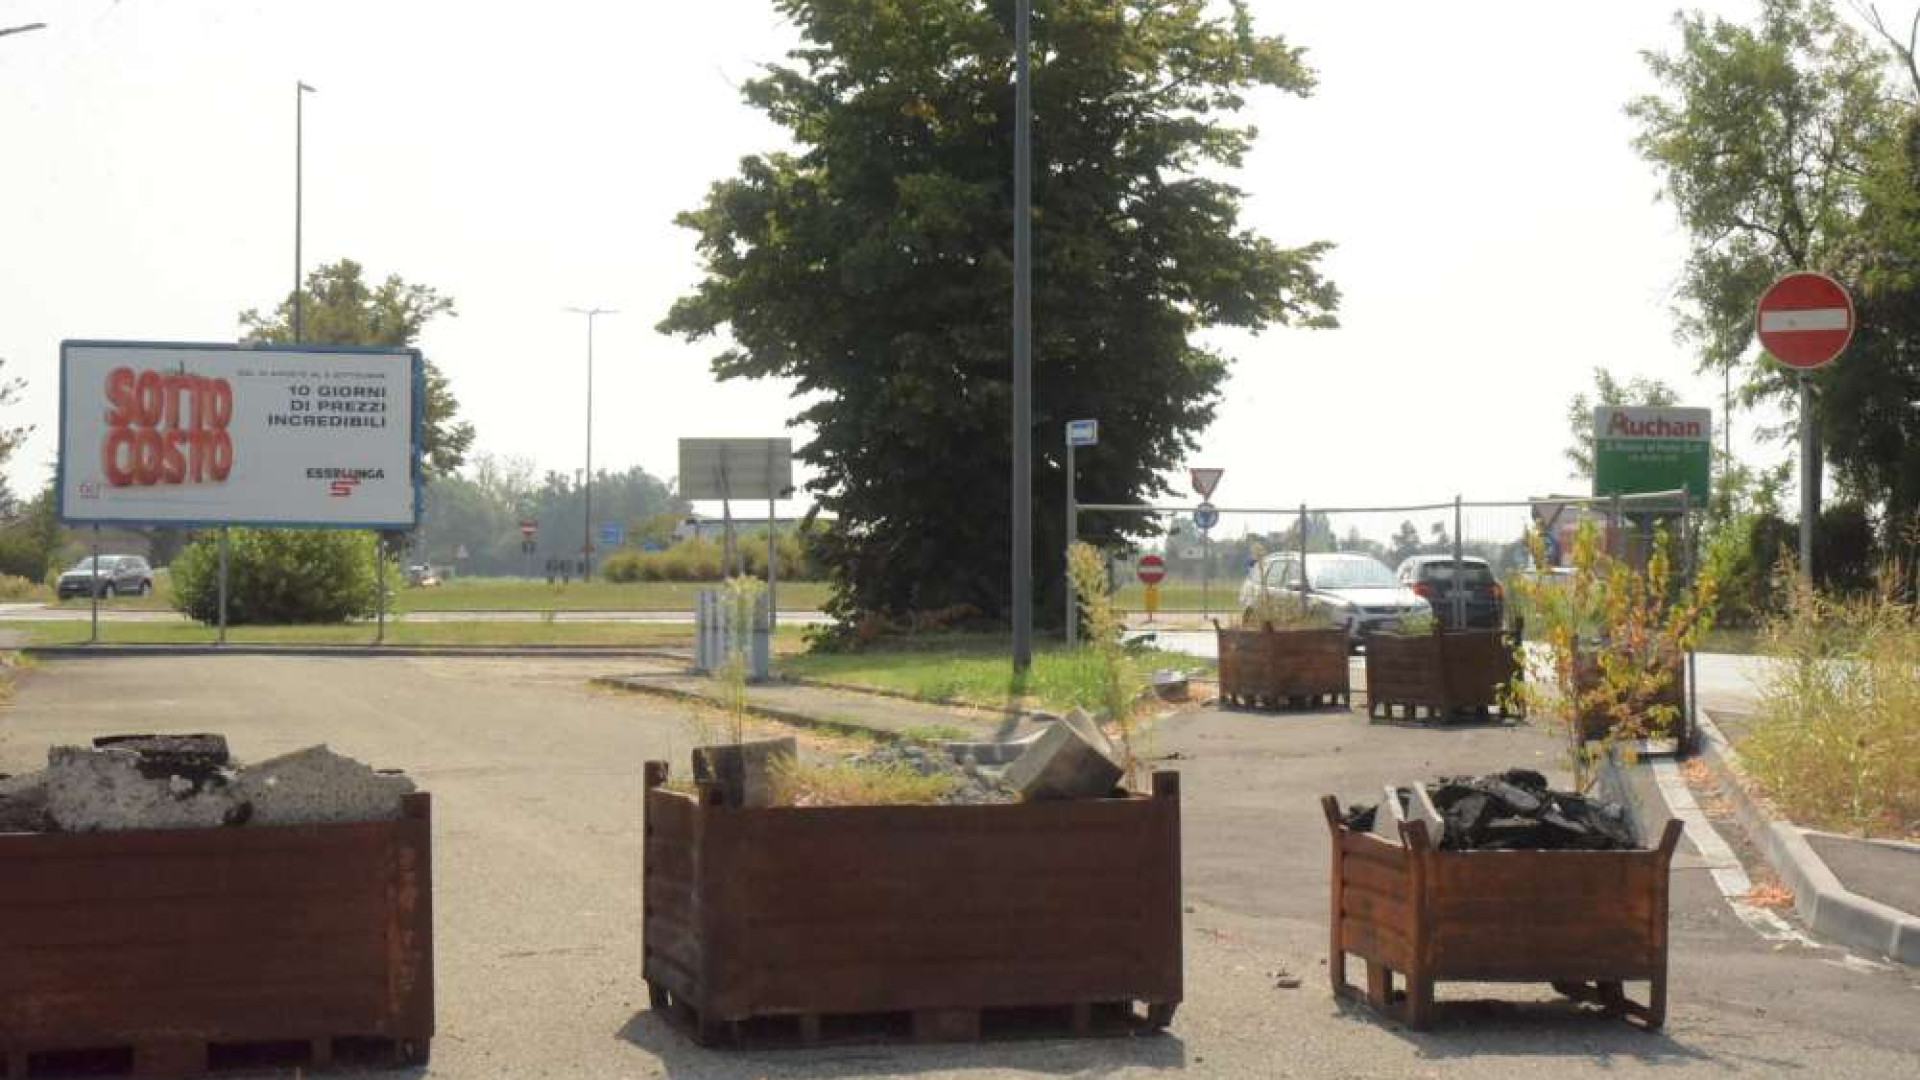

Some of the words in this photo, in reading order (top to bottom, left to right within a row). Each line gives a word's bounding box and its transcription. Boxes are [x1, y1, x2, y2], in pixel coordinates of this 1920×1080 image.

[104, 366, 233, 428] SOTTO
[290, 385, 310, 397] 10
[318, 386, 386, 398] GIORNI
[291, 400, 310, 412] DI
[318, 400, 386, 413] PREZZI
[268, 413, 386, 428] INCREDIBILI
[1608, 410, 1701, 438] Auchan
[103, 426, 233, 486] COSTO
